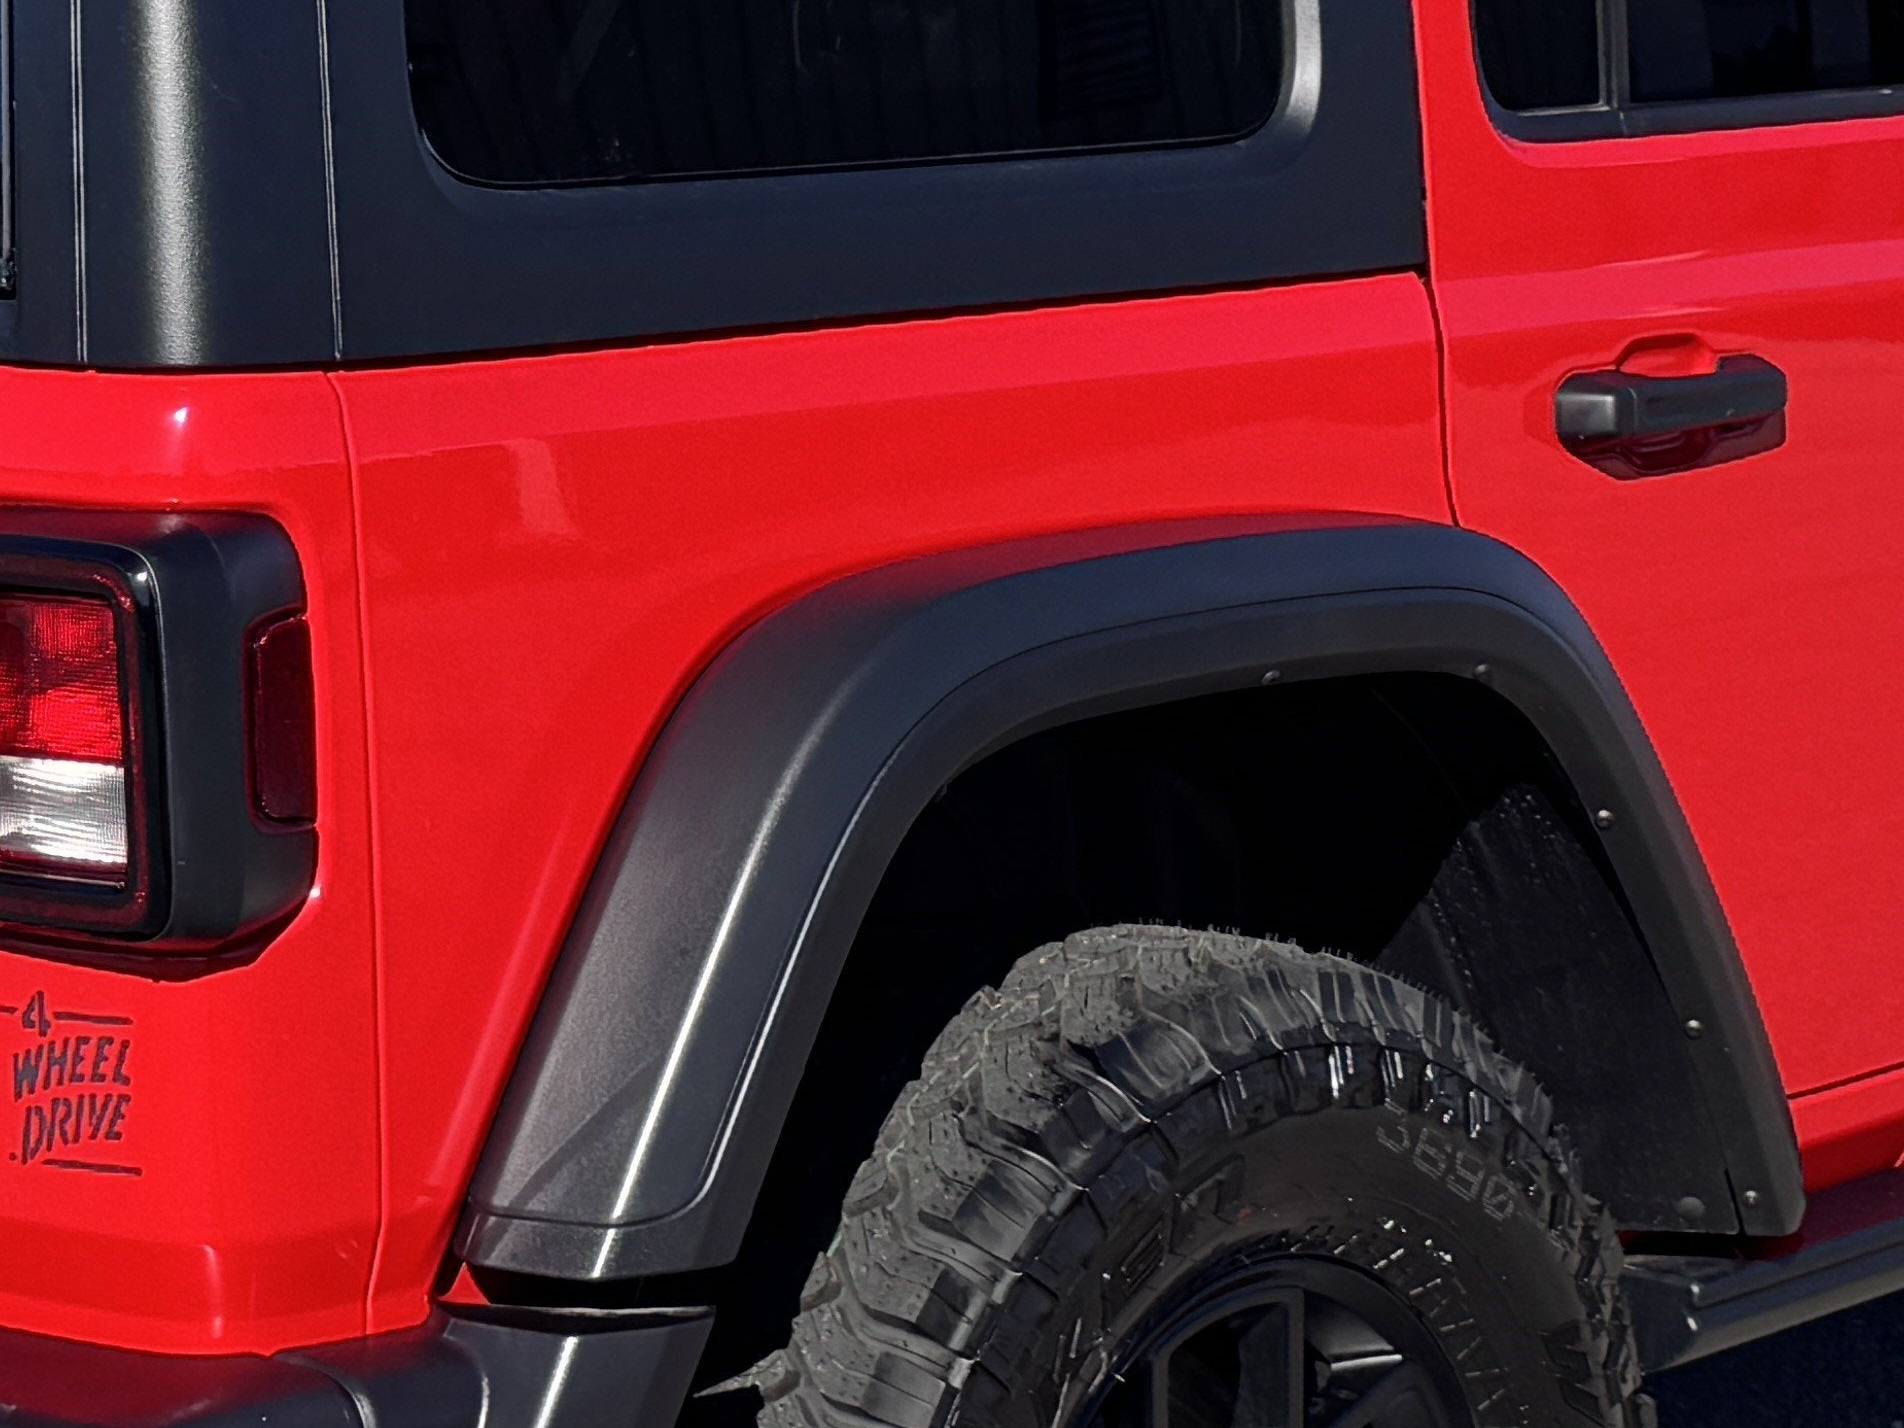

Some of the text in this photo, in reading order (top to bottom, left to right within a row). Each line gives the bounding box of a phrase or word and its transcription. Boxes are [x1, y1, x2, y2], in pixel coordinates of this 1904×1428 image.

[21, 990, 51, 1037] 4
[12, 1036, 132, 1102] WHEEL
[20, 1093, 132, 1165] DRIVE
